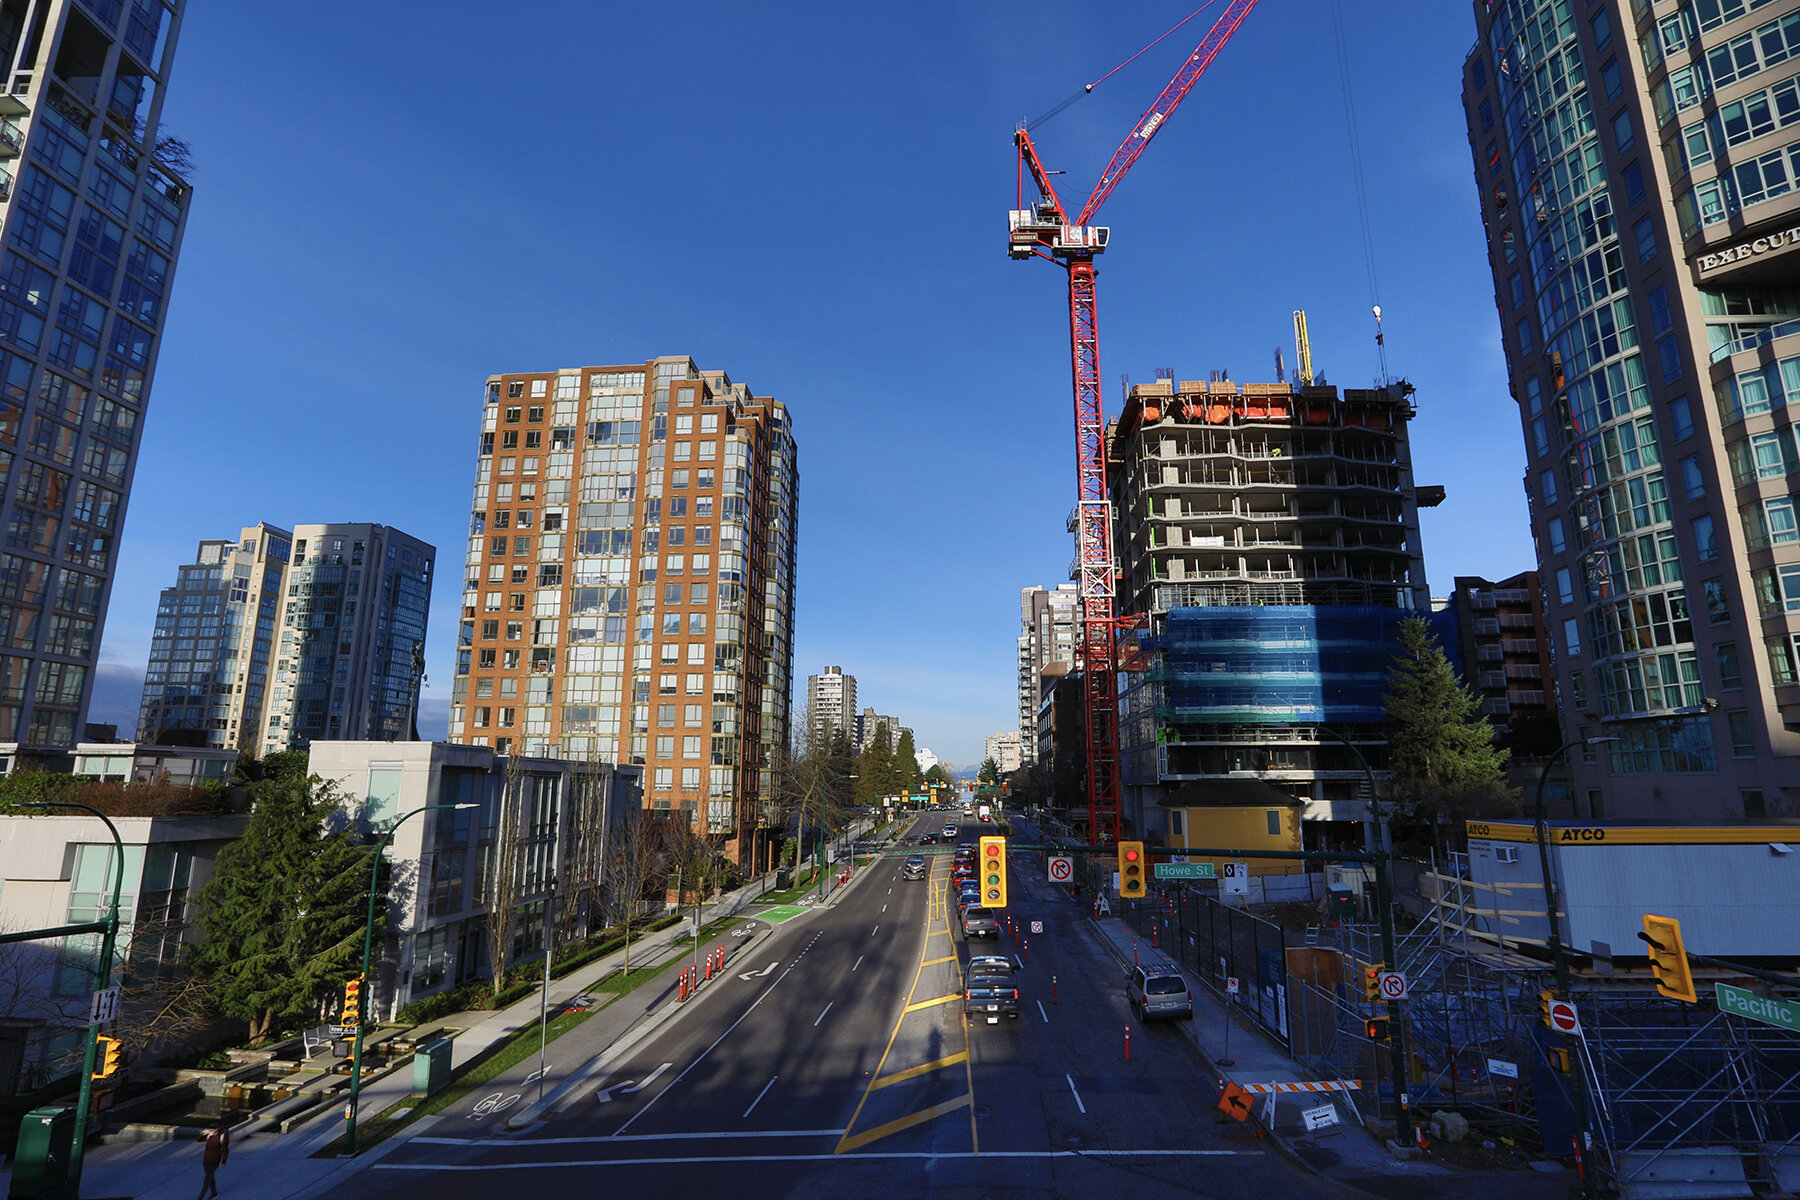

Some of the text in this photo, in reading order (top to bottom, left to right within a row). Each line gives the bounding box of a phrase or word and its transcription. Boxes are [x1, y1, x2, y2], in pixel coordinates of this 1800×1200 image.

[1701, 226, 1800, 271] EXECUT
[1468, 824, 1490, 835] ATCO
[1561, 828, 1605, 841] ATCO
[1160, 865, 1209, 876] Howe St
[1724, 989, 1793, 1023] Pacific
